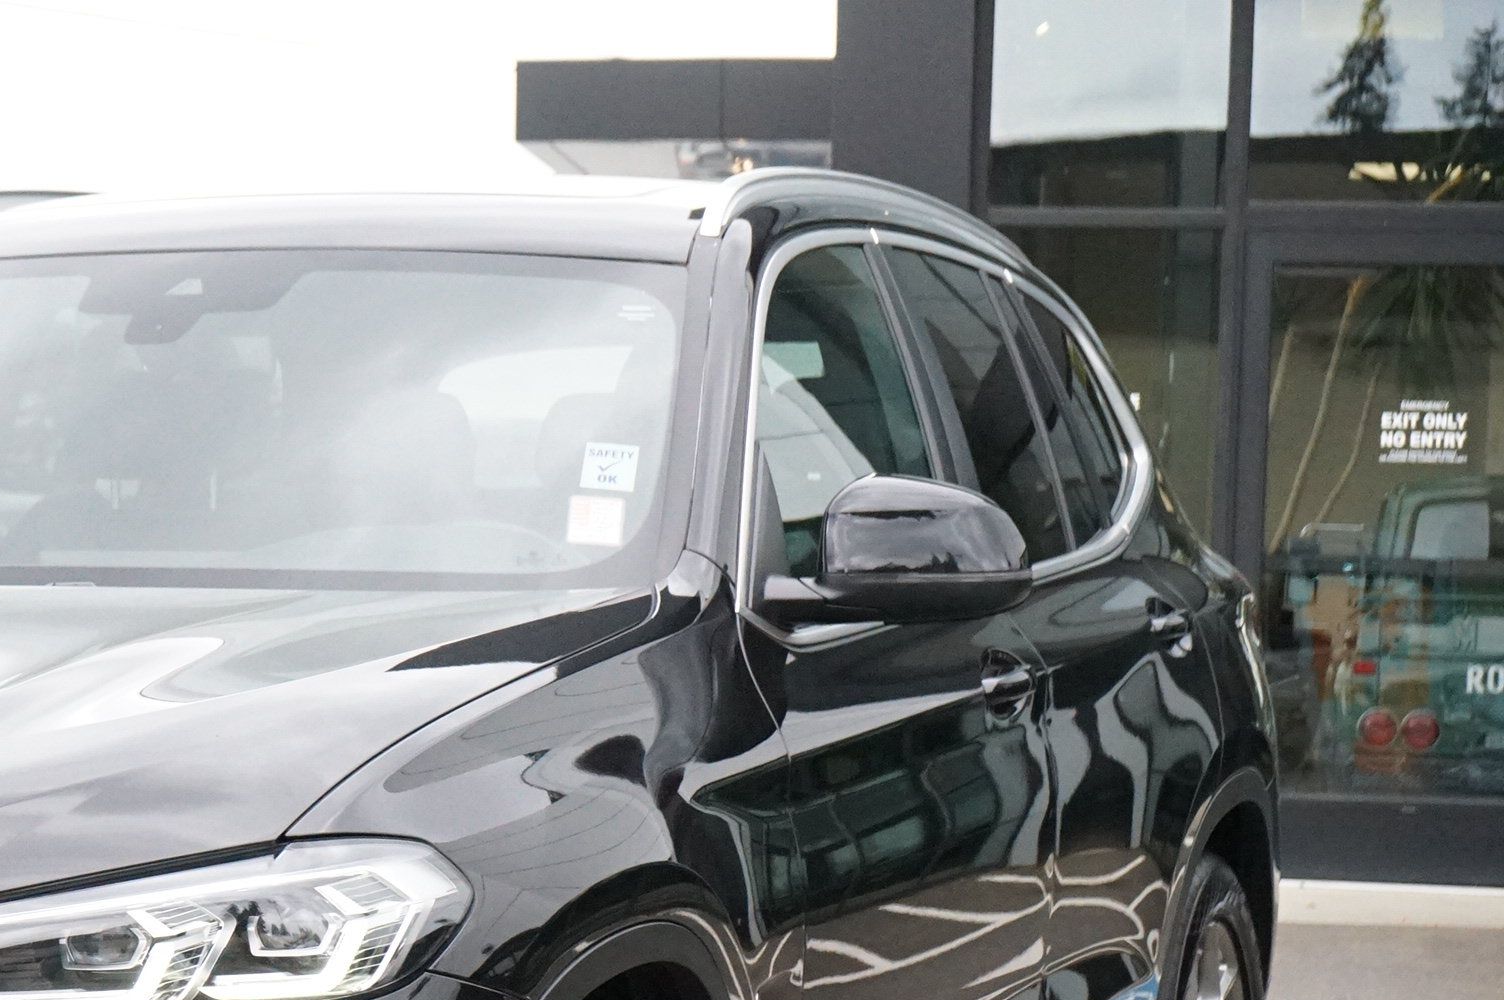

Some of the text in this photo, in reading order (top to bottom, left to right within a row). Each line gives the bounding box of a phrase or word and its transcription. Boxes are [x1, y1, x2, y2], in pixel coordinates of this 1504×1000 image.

[1381, 411, 1468, 431] EXIT ONLY
[1380, 430, 1467, 450] NO ENTRY
[590, 448, 634, 459] SAFETY
[598, 474, 617, 483] OK
